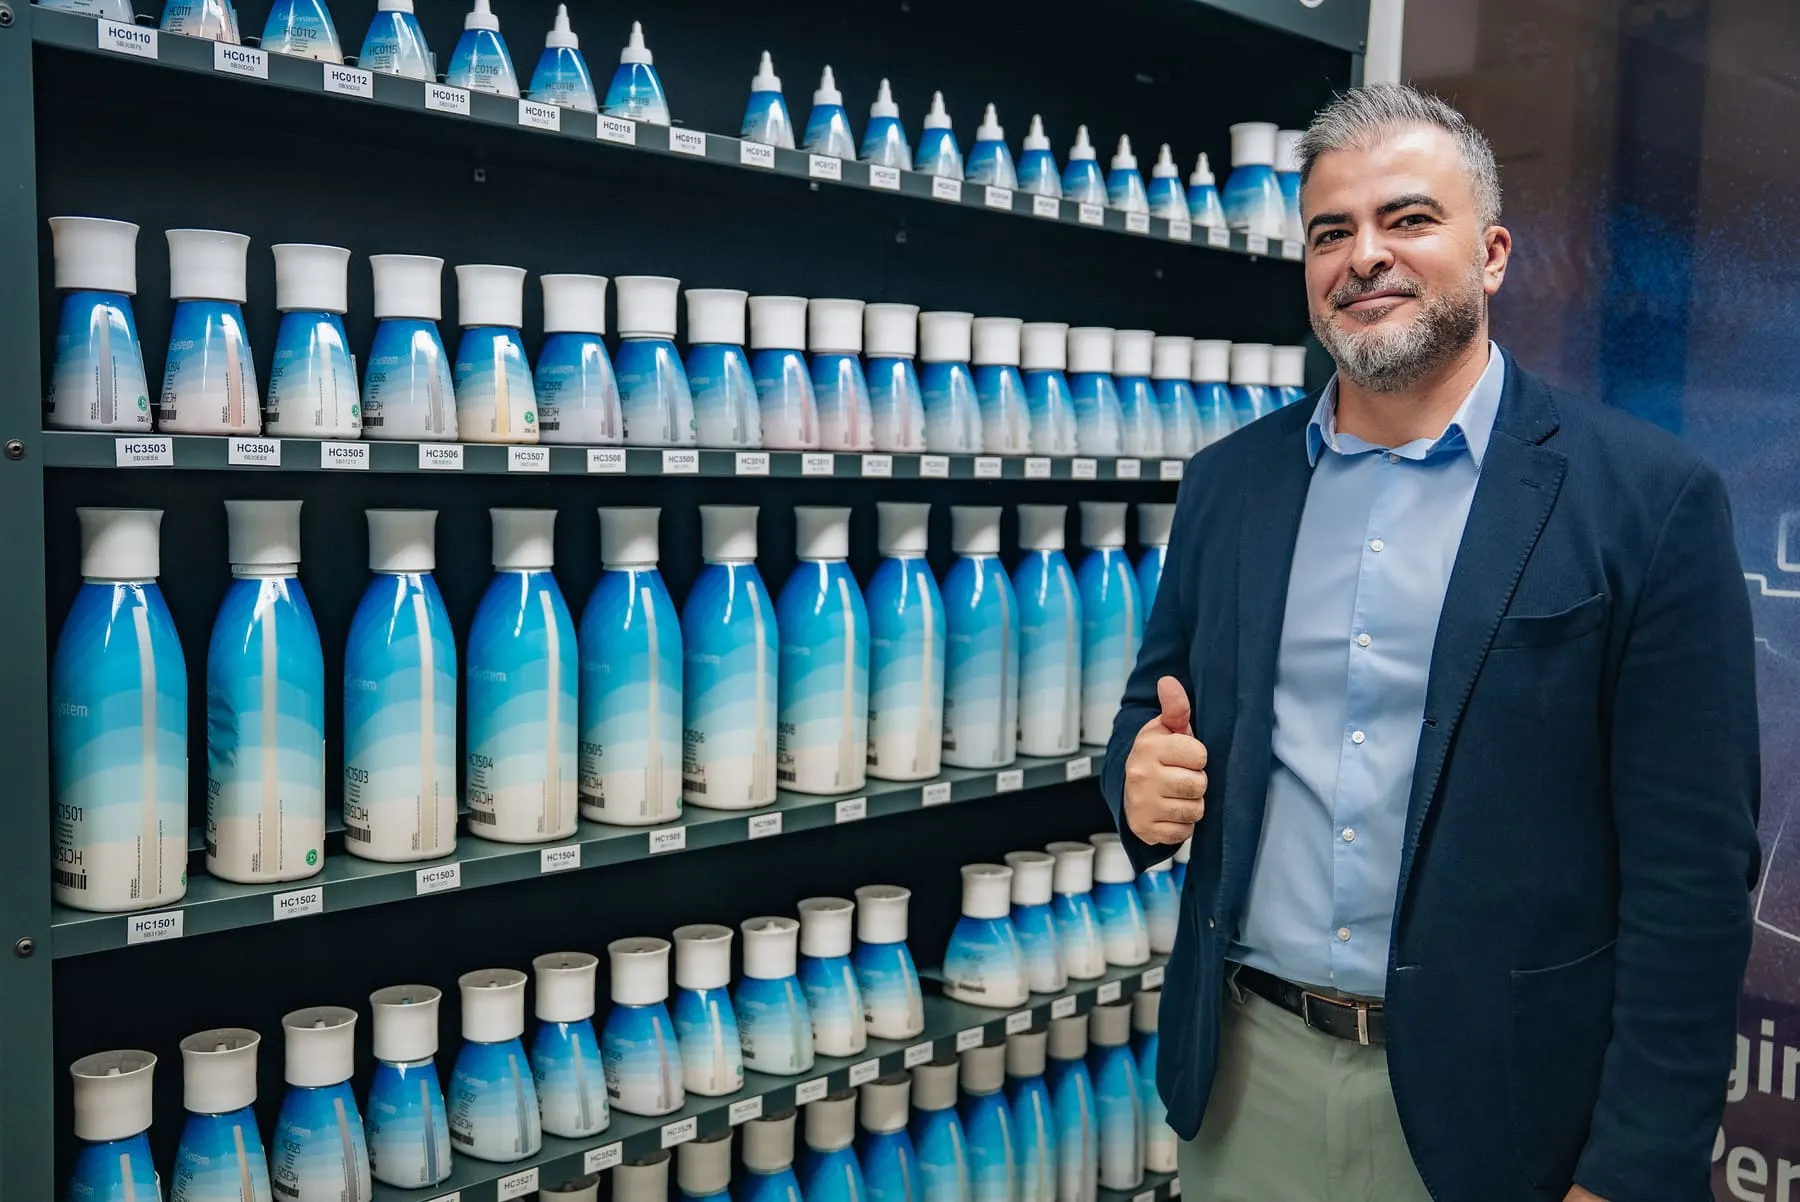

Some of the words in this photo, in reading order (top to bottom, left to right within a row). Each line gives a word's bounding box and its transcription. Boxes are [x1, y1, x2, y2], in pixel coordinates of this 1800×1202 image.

[108, 26, 151, 44] HC0110
[223, 49, 261, 65] HC0111
[331, 70, 368, 85] HC0112
[432, 89, 465, 103] HC0115
[525, 105, 556, 119] HC0116
[602, 120, 632, 134] HC0118
[675, 132, 702, 145] HC0119
[125, 443, 167, 454] HC3503
[237, 443, 276, 454] HC3504
[328, 447, 364, 458] HC3505
[426, 449, 459, 459] HC3506
[514, 452, 545, 462] HC3507
[593, 454, 622, 463] HC3508
[668, 456, 695, 464] HC3509
[547, 850, 576, 862] HC1504
[422, 869, 455, 883] HC1503
[280, 894, 317, 909] HC1502
[135, 918, 176, 932] HC1501
[505, 1174, 534, 1191] HC3527
